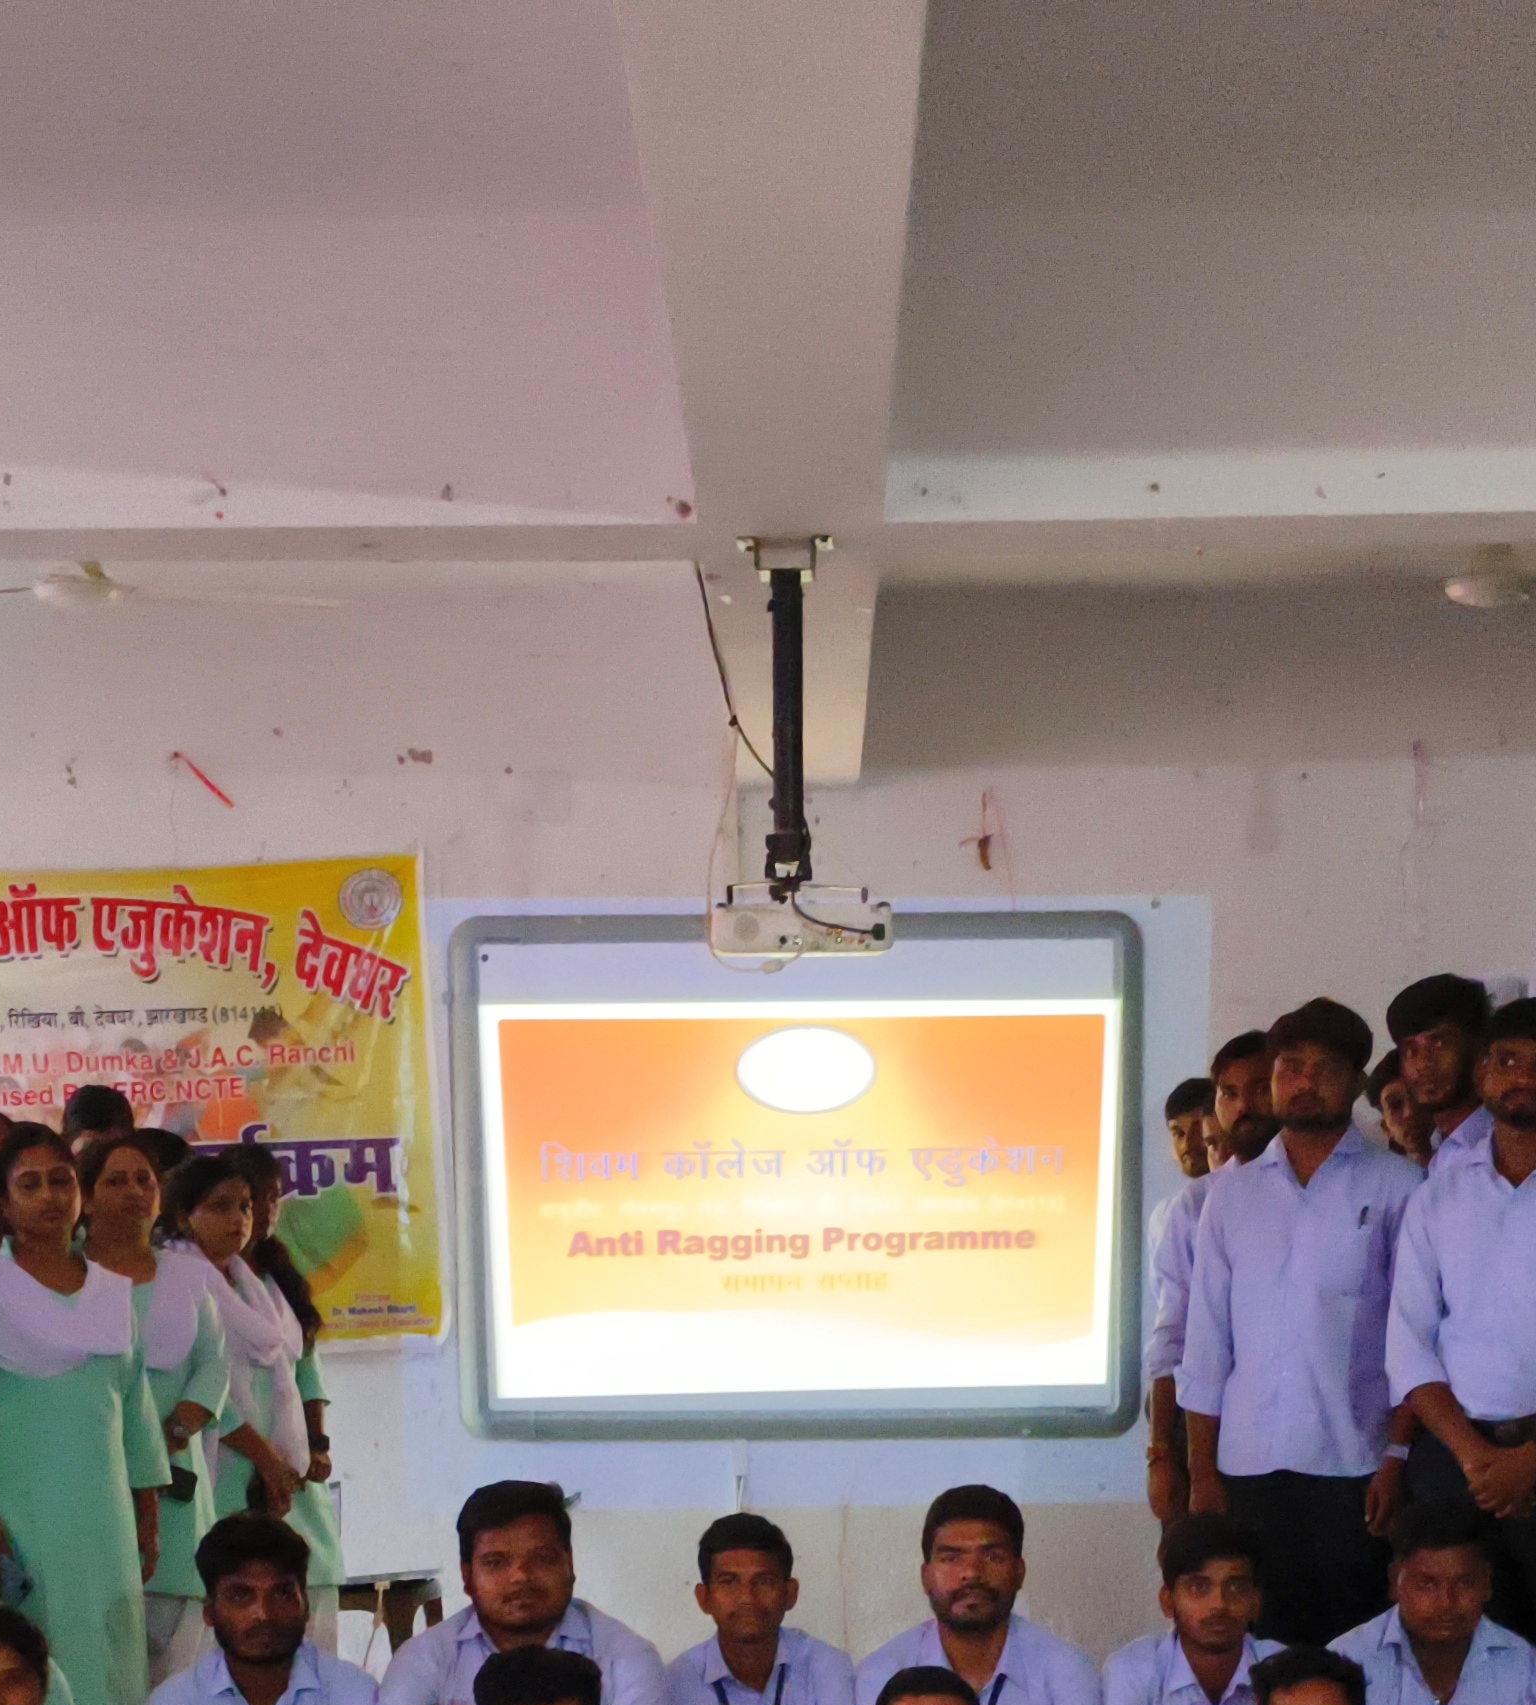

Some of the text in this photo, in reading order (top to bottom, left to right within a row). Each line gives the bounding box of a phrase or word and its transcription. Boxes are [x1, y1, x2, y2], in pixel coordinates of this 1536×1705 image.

[91, 885, 276, 989] एजुकेशन,
[295, 910, 408, 1019] देवघर
[66, 1051, 154, 1073] Dumka
[164, 1049, 178, 1068] &
[189, 1045, 260, 1068] J.A.C.
[269, 1041, 355, 1065] Ranchi
[540, 1136, 1065, 1188] शिवम कॉलेज ऑफ एडुकेशन
[567, 1225, 1037, 1261] Anti Ragging Programme
